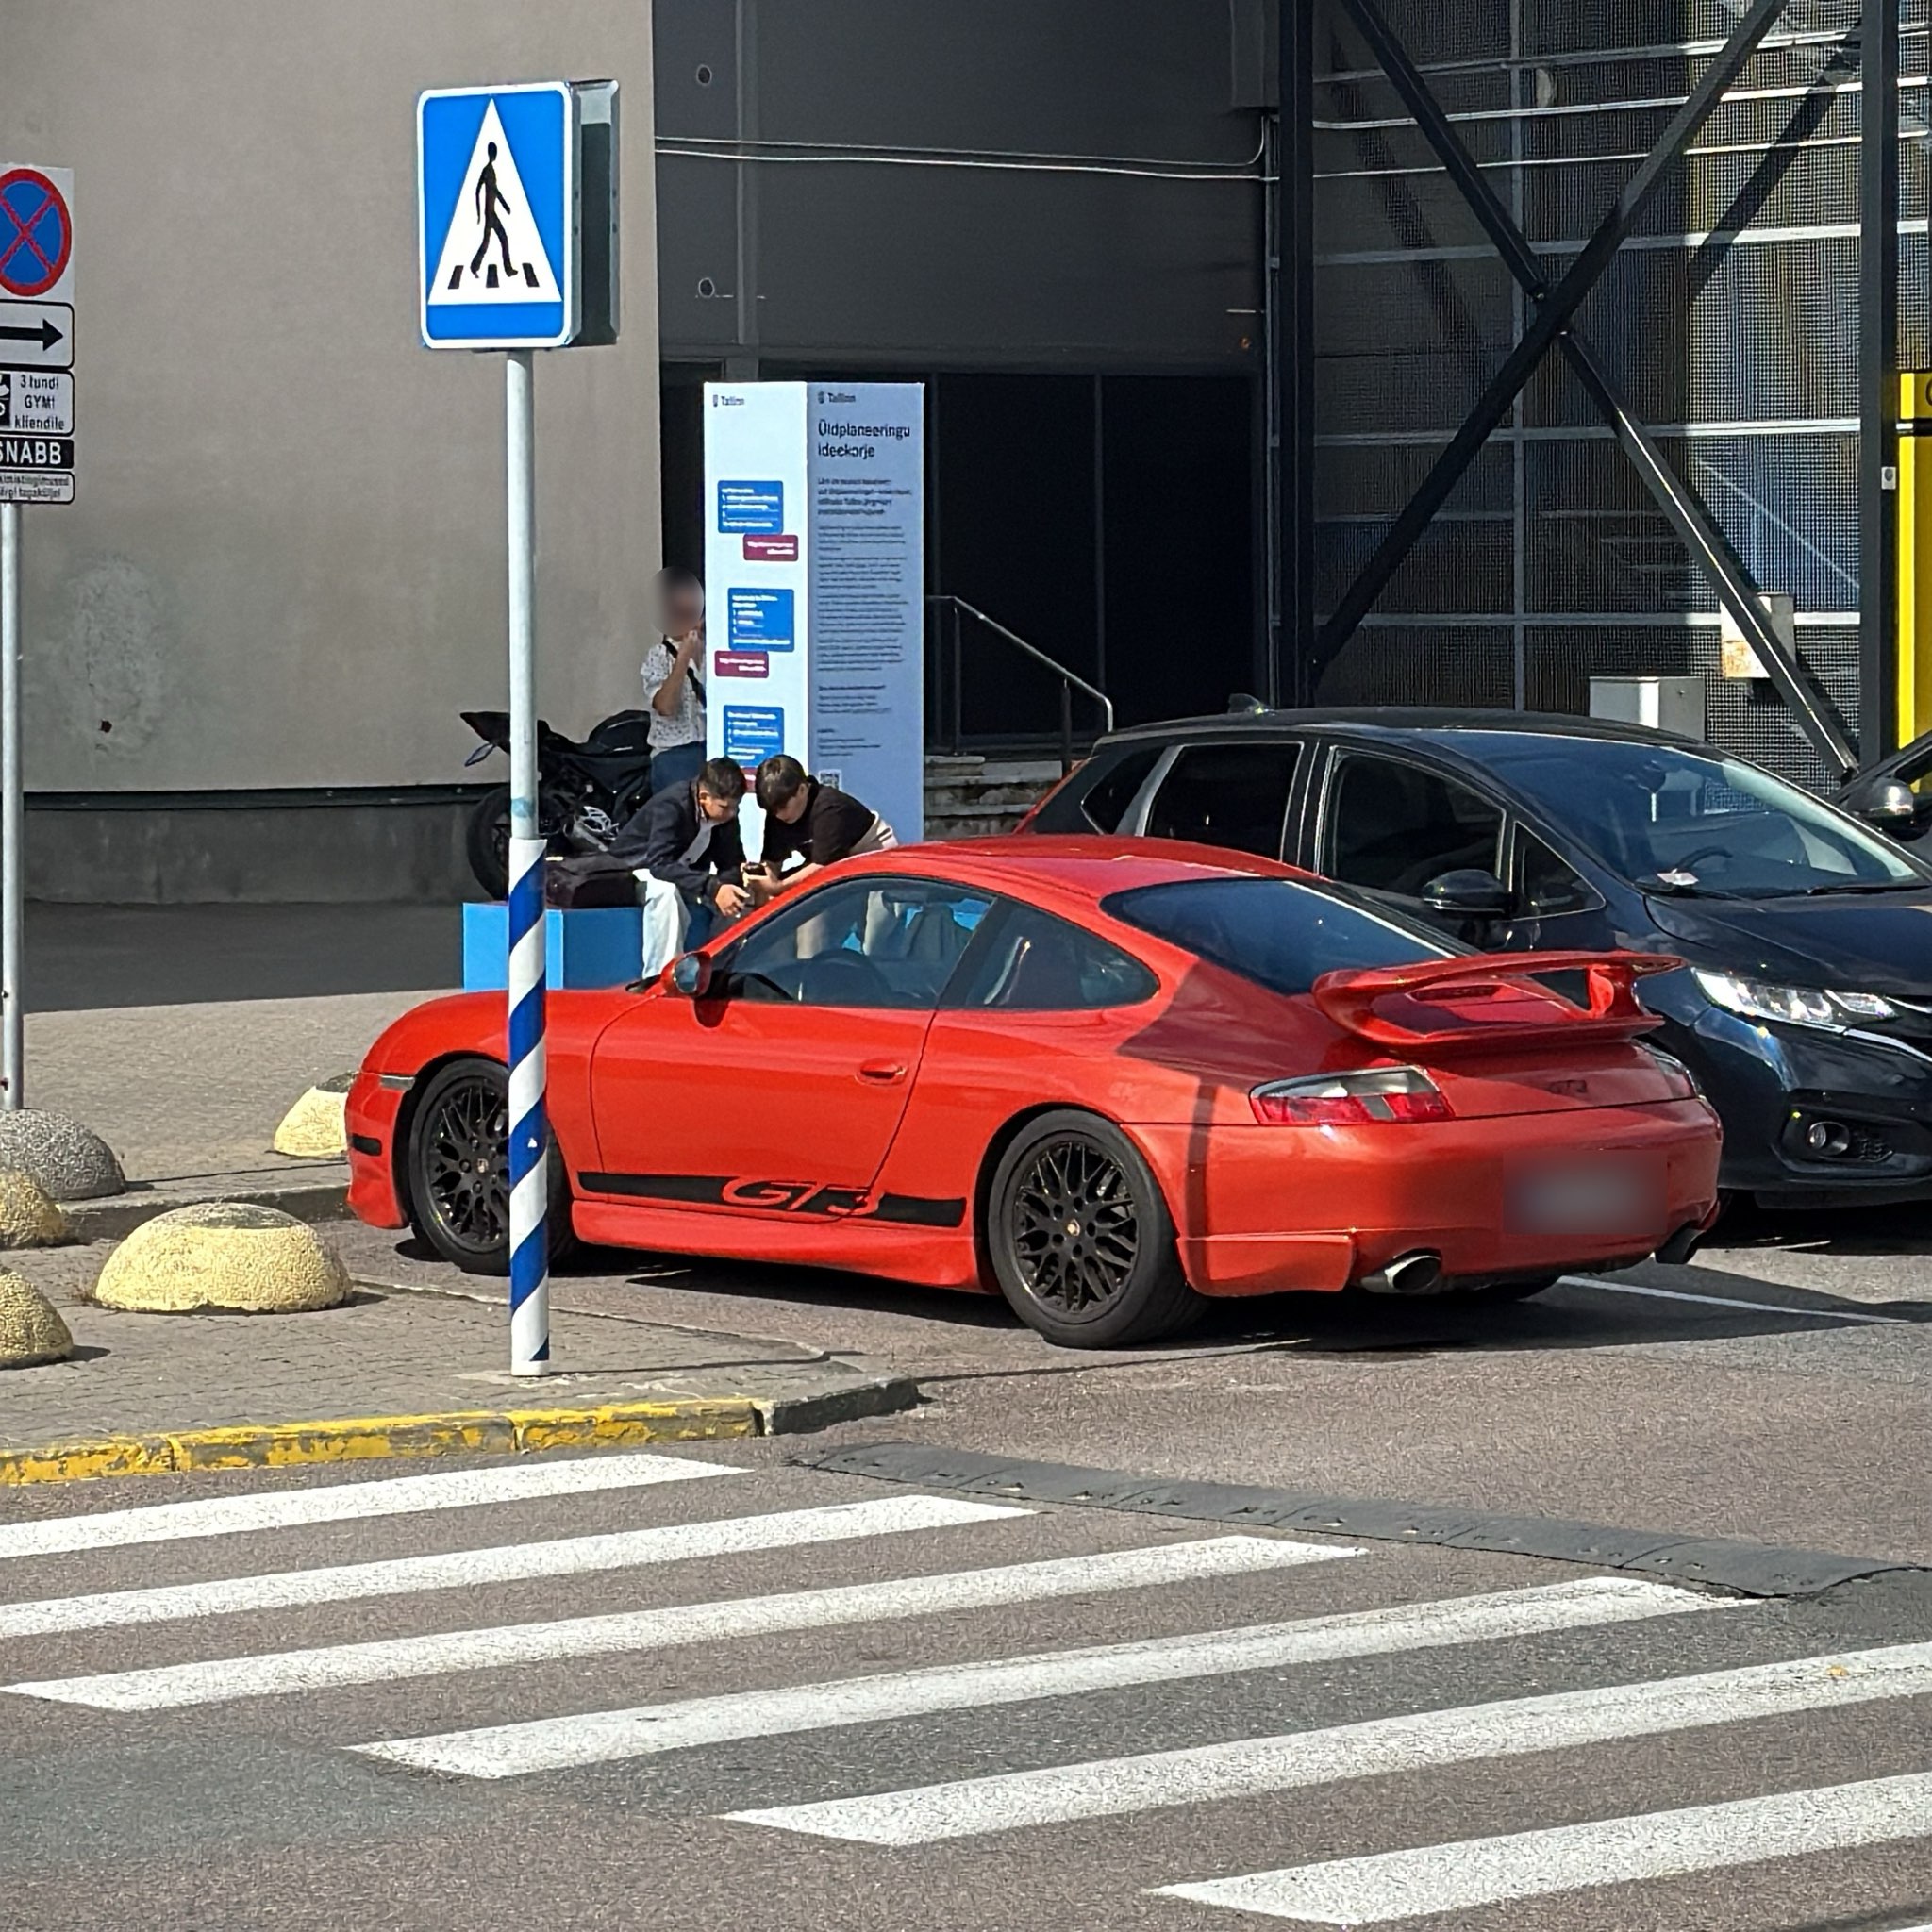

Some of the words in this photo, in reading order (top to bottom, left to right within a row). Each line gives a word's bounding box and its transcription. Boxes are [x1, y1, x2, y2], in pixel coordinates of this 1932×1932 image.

[20, 374, 26, 389] 3
[29, 375, 59, 390] tundi
[14, 414, 65, 431] kliendile
[722, 1177, 885, 1216] GT3
